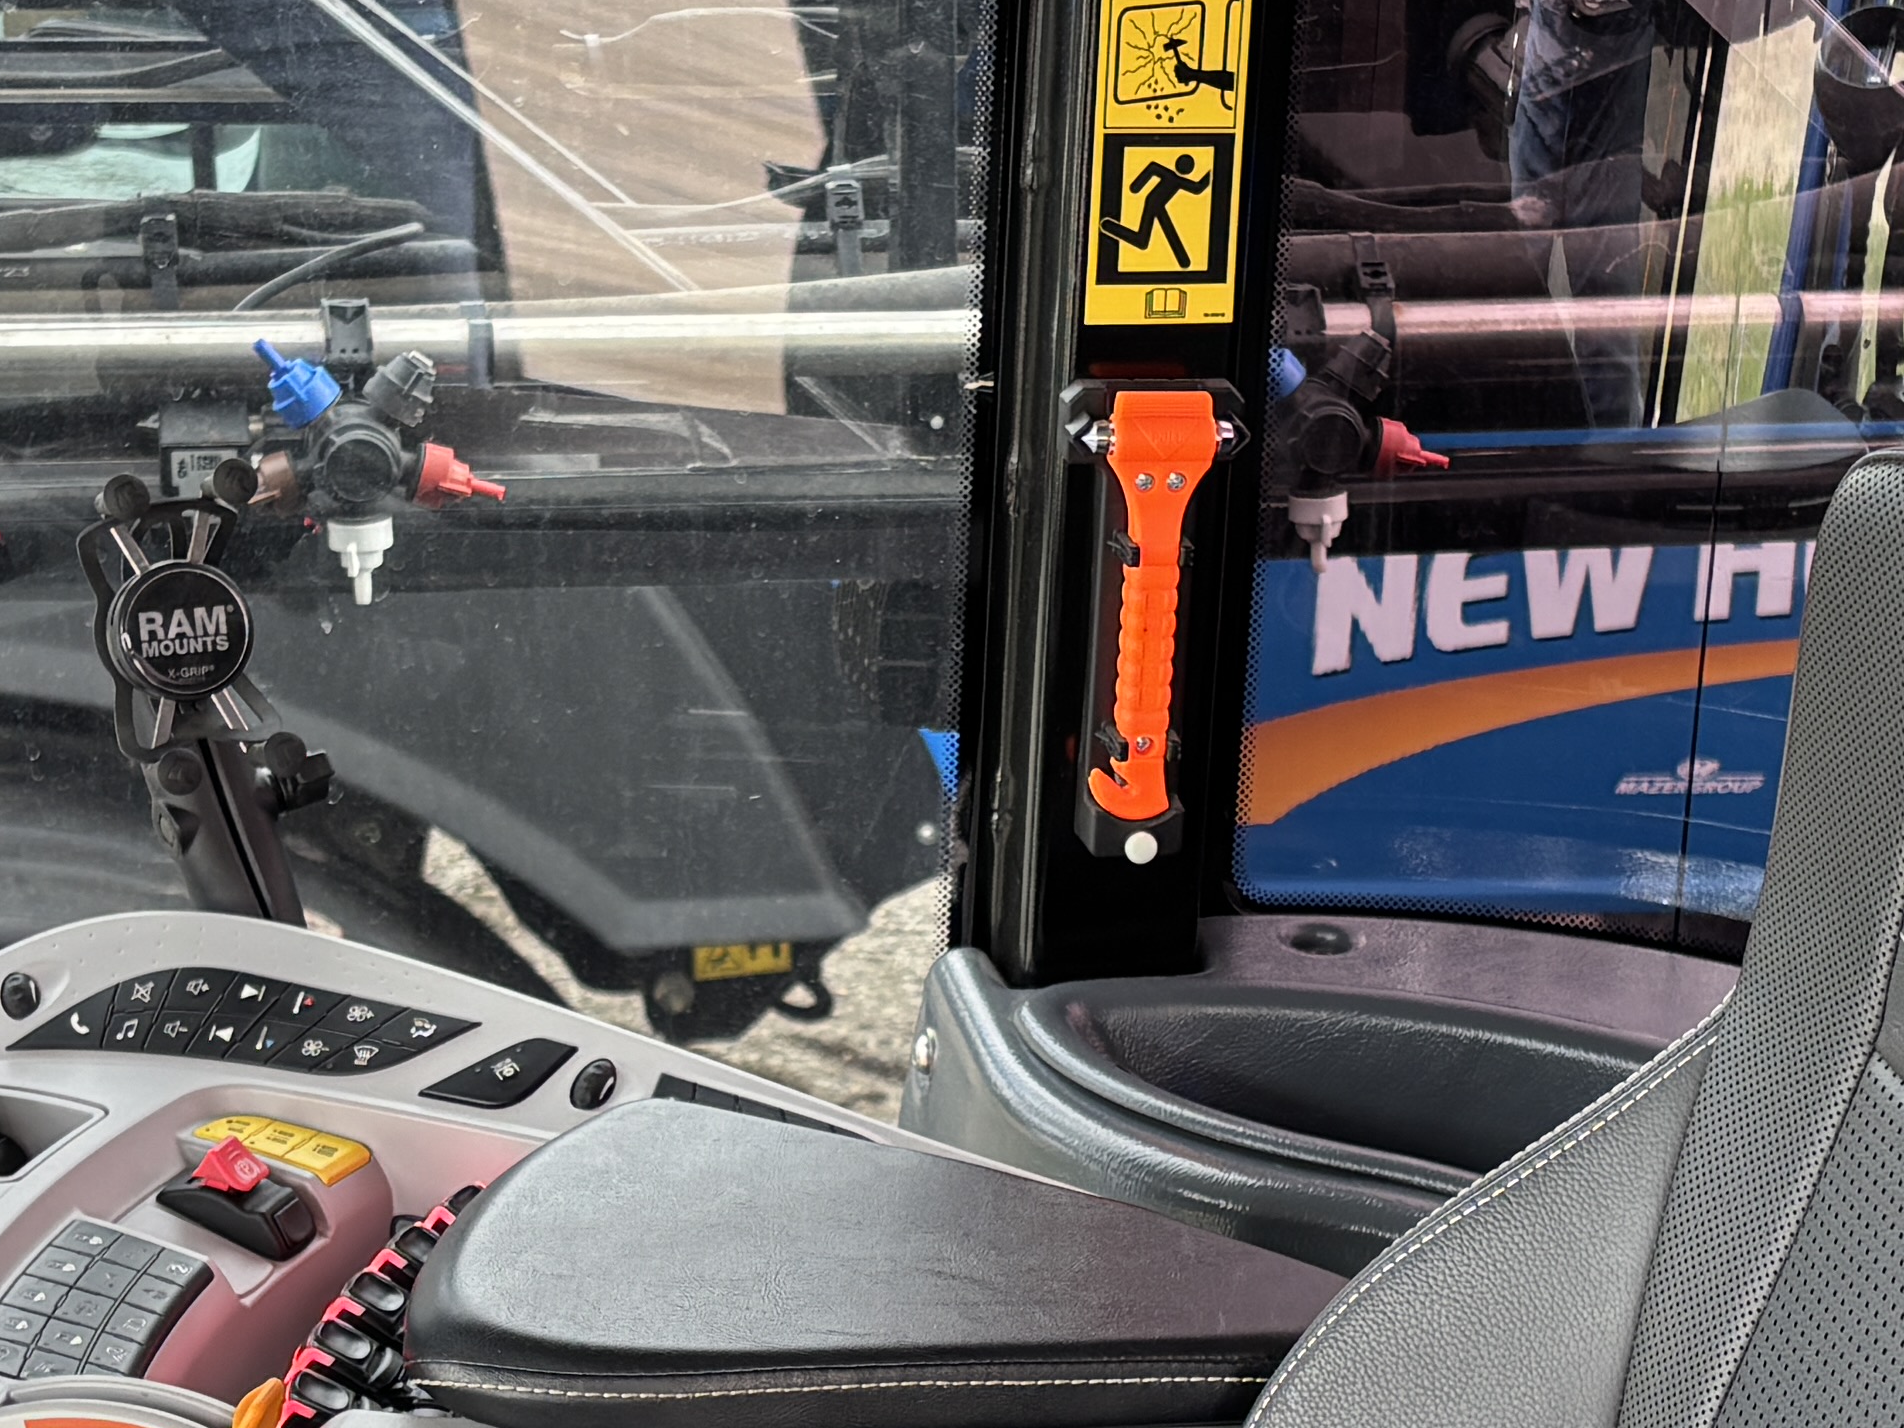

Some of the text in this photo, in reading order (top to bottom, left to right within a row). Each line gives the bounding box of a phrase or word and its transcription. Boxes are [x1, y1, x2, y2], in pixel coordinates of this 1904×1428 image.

[138, 605, 228, 642] RAM
[1312, 540, 1816, 677] NEW H
[141, 635, 230, 659] MOUNTS
